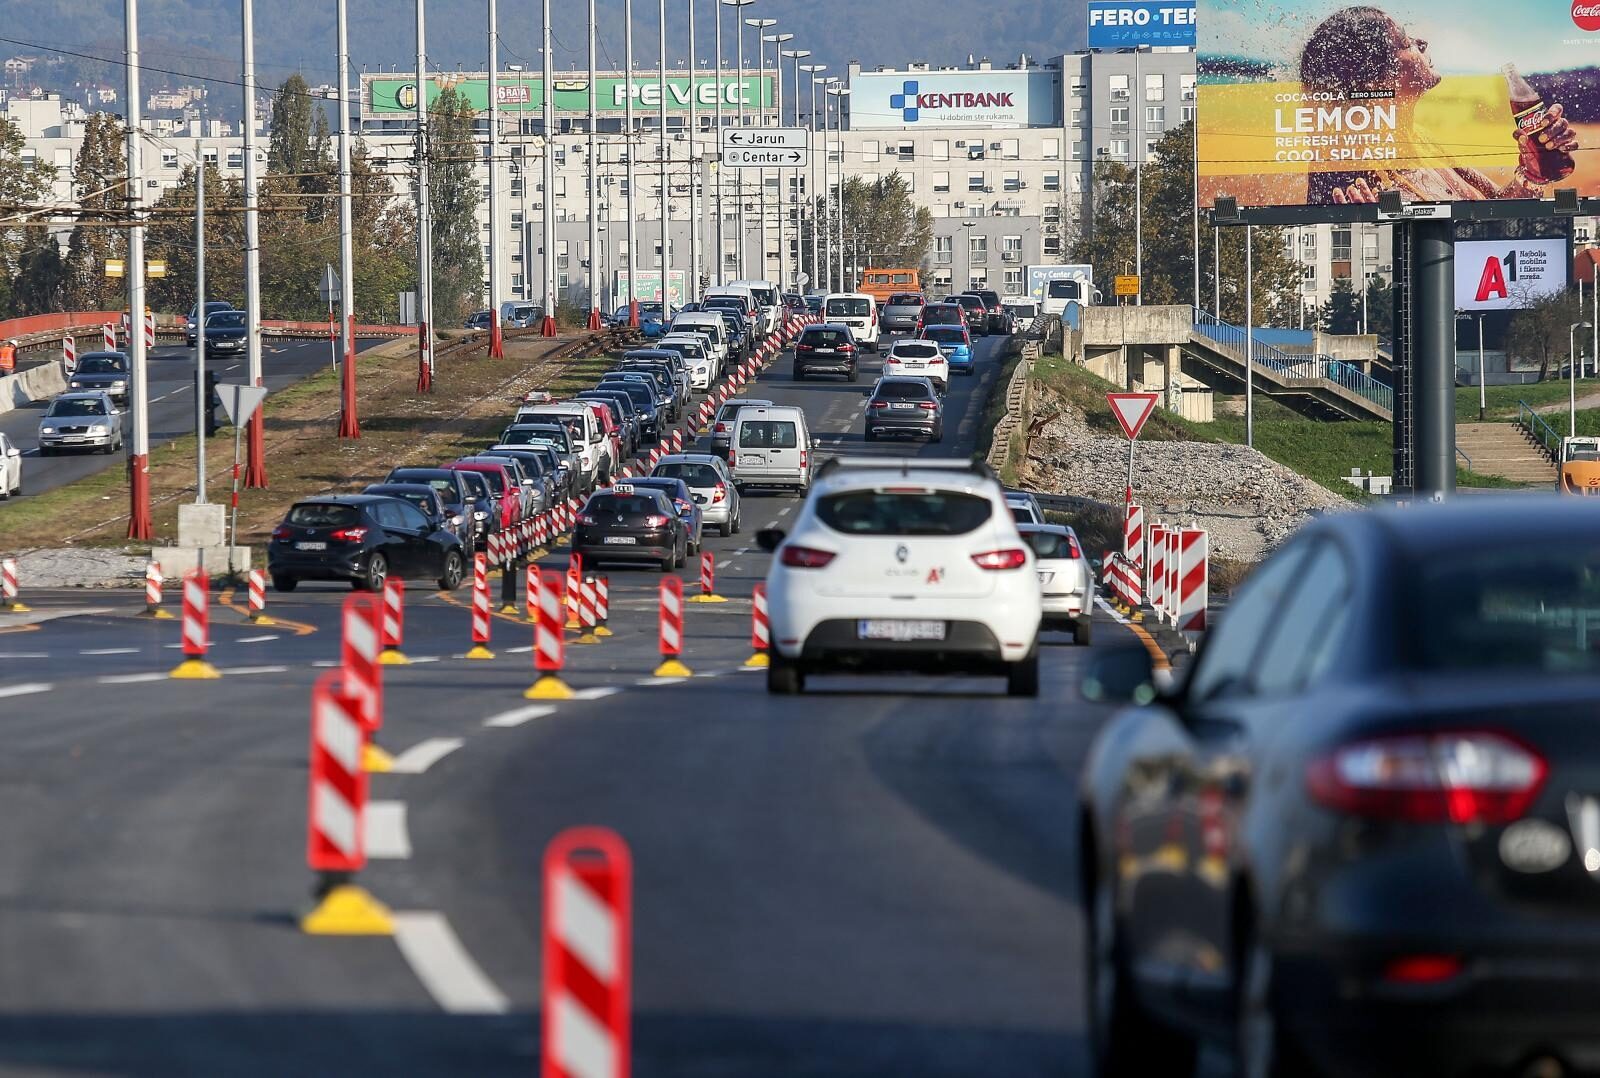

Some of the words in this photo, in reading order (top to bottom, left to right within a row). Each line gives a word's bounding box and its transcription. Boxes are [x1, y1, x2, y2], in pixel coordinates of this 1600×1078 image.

[1090, 8, 1151, 26] FERO
[506, 88, 527, 98] RATA
[613, 83, 750, 106] PEVEC
[1275, 91, 1345, 103] COCA-COLA
[1350, 91, 1369, 99] ZERO
[1370, 90, 1394, 98] SUGAR
[917, 92, 1015, 109] KENTBANK
[940, 113, 946, 121] U
[947, 112, 973, 121] dobrim
[1275, 104, 1396, 133] LEMON
[747, 132, 785, 144] Jarun
[1275, 134, 1339, 148] REFRESH
[1343, 133, 1381, 146] WITH
[1385, 132, 1396, 144] A
[742, 151, 785, 162] Centar
[1275, 148, 1325, 163] COOL
[1329, 146, 1397, 162] SPLASH
[1519, 250, 1547, 259] Najbolja
[1033, 271, 1046, 280] City
[1048, 270, 1072, 278] Center
[1523, 265, 1545, 273] fiksna
[1475, 250, 1517, 302] A1
